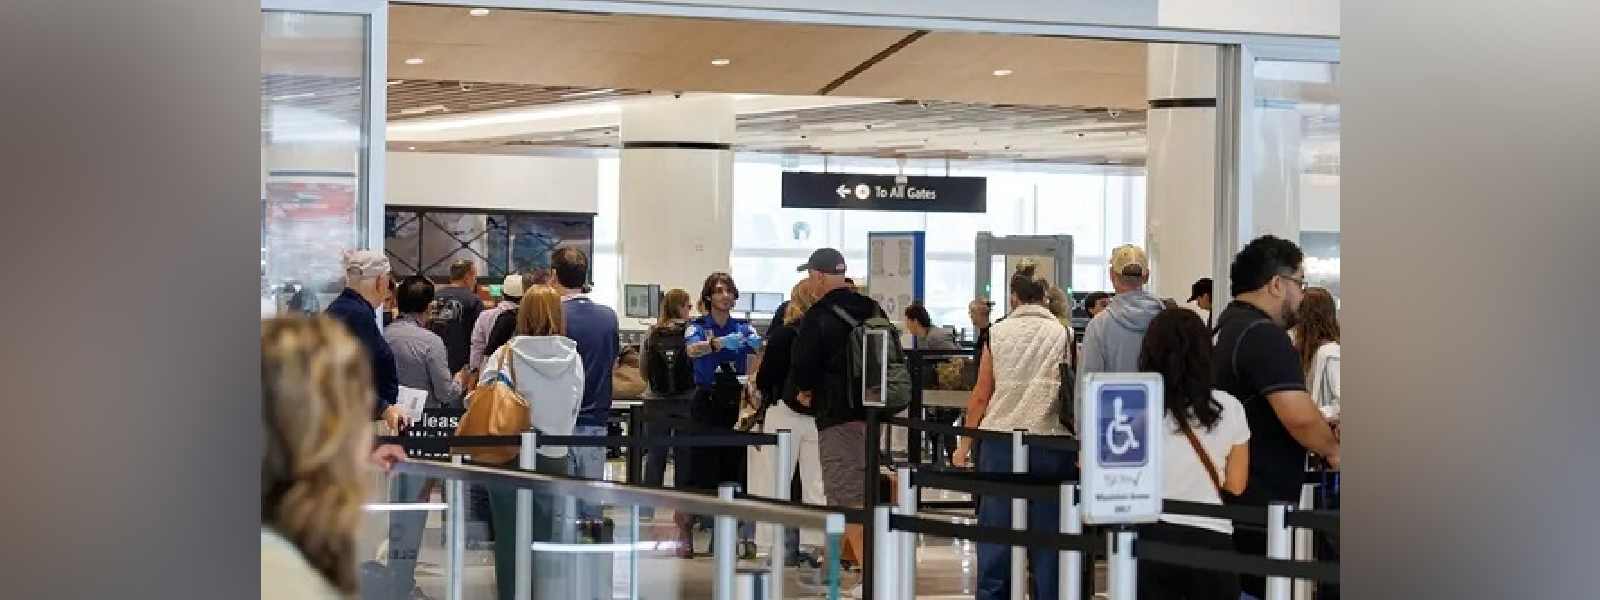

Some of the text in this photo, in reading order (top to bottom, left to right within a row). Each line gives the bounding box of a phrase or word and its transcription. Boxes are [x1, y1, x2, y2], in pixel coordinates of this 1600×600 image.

[874, 185, 888, 198] To
[907, 187, 936, 200] Gates
[411, 412, 459, 428] leas
